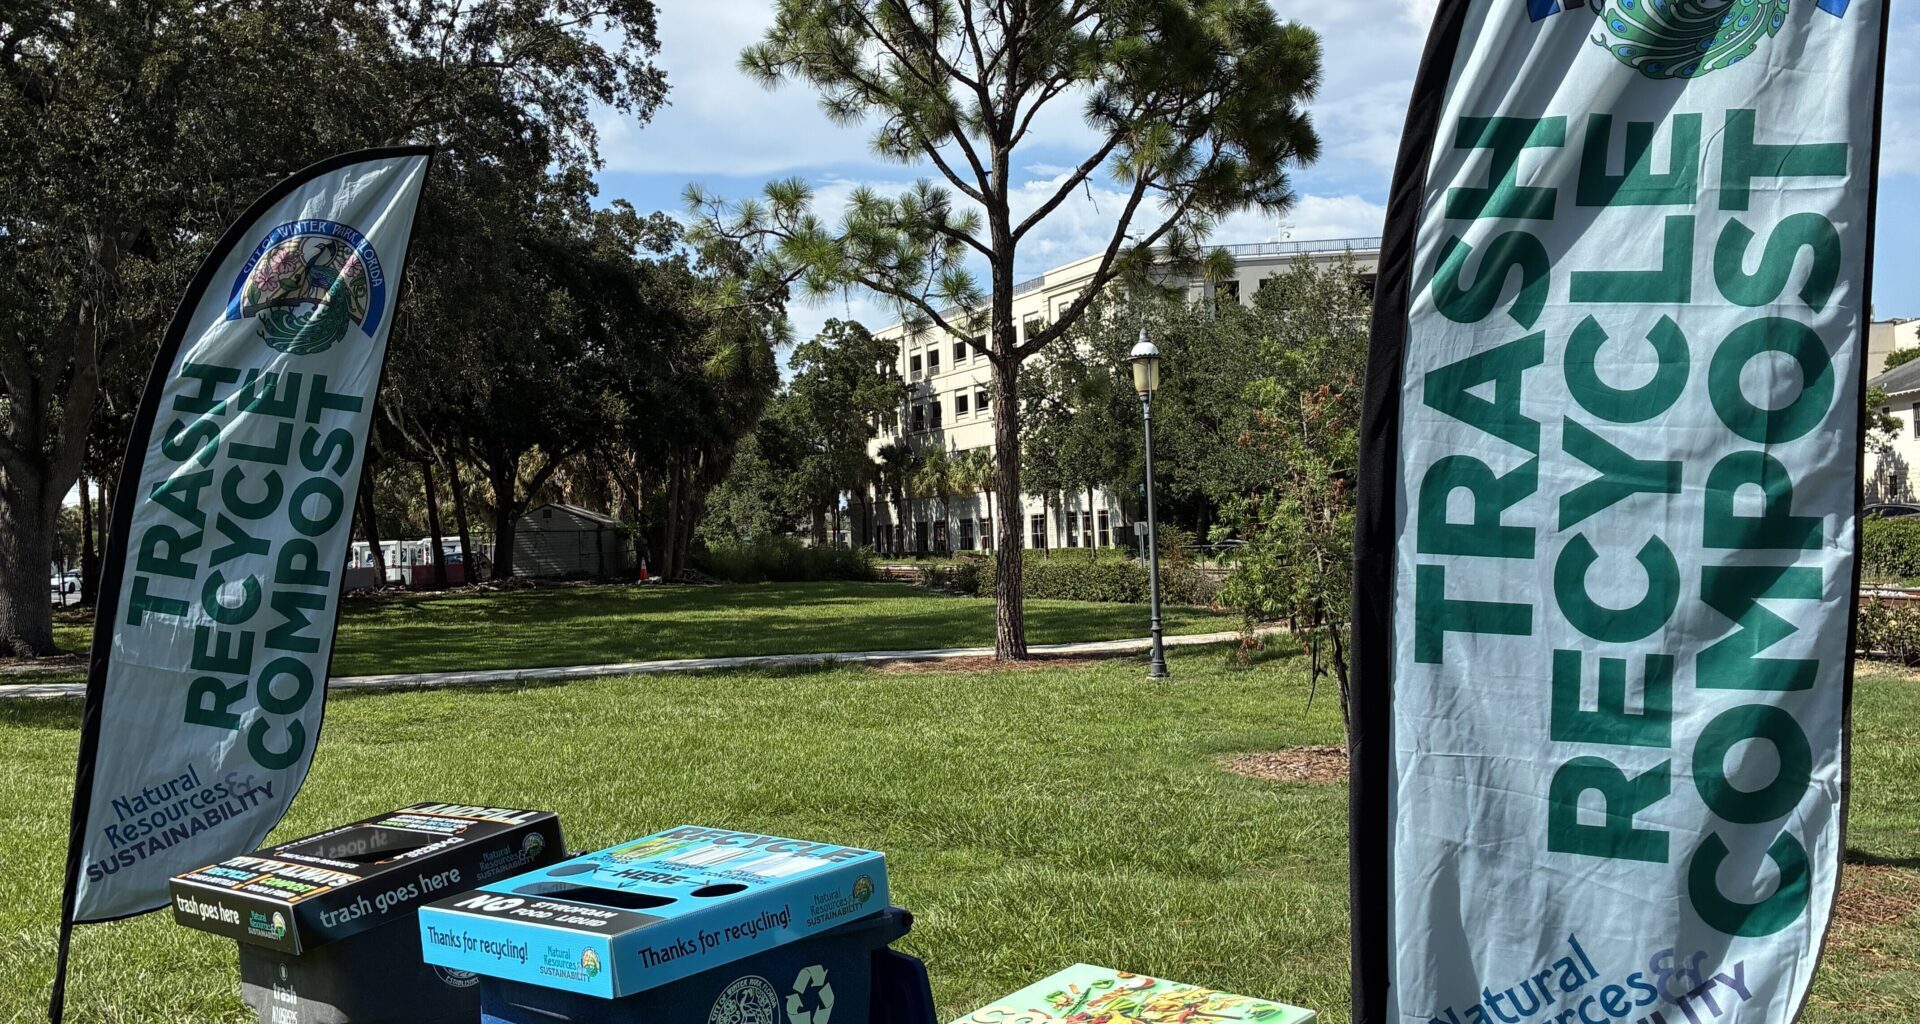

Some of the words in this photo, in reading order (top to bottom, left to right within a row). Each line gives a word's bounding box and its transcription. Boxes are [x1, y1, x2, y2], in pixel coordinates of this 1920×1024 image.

[243, 250, 261, 274] CITY
[261, 233, 275, 249] OF
[278, 220, 327, 238] WINTER
[356, 238, 383, 287] FLORIDA
[1414, 115, 1567, 664] TRASH
[127, 362, 241, 627] TRASH
[1547, 112, 1702, 864] RECYCLE
[1688, 108, 1848, 938] COMPOST
[184, 368, 303, 730] RECYCLE
[248, 374, 364, 770] COMPOST
[111, 763, 202, 822] Natural
[394, 803, 539, 821] LANDFILL
[86, 780, 274, 883] SUSTAINABILITY
[657, 826, 870, 863] RECYCLE
[483, 844, 510, 861] Natural
[248, 861, 286, 873] TO
[269, 865, 352, 887] ALWAYS
[611, 867, 690, 885] HERE
[177, 894, 199, 916] trash
[199, 901, 219, 921] goes
[219, 901, 240, 925] here
[320, 894, 373, 928] trash
[375, 883, 418, 914] goes
[418, 868, 461, 894] here
[453, 894, 525, 912] NO
[806, 902, 864, 927] SUSTAINABILITY
[813, 888, 841, 905] Natural
[509, 908, 553, 918] FOOD
[554, 914, 608, 927] LIQUID
[638, 936, 697, 969] Thanks
[698, 930, 721, 955] for
[724, 904, 792, 943] recycling!
[427, 926, 462, 949] Thanks
[462, 931, 478, 954] for
[479, 939, 529, 965] recycling!
[547, 945, 570, 960] Natural
[539, 966, 591, 982] SUSTAINABILITY
[1428, 932, 1600, 1024] tural
